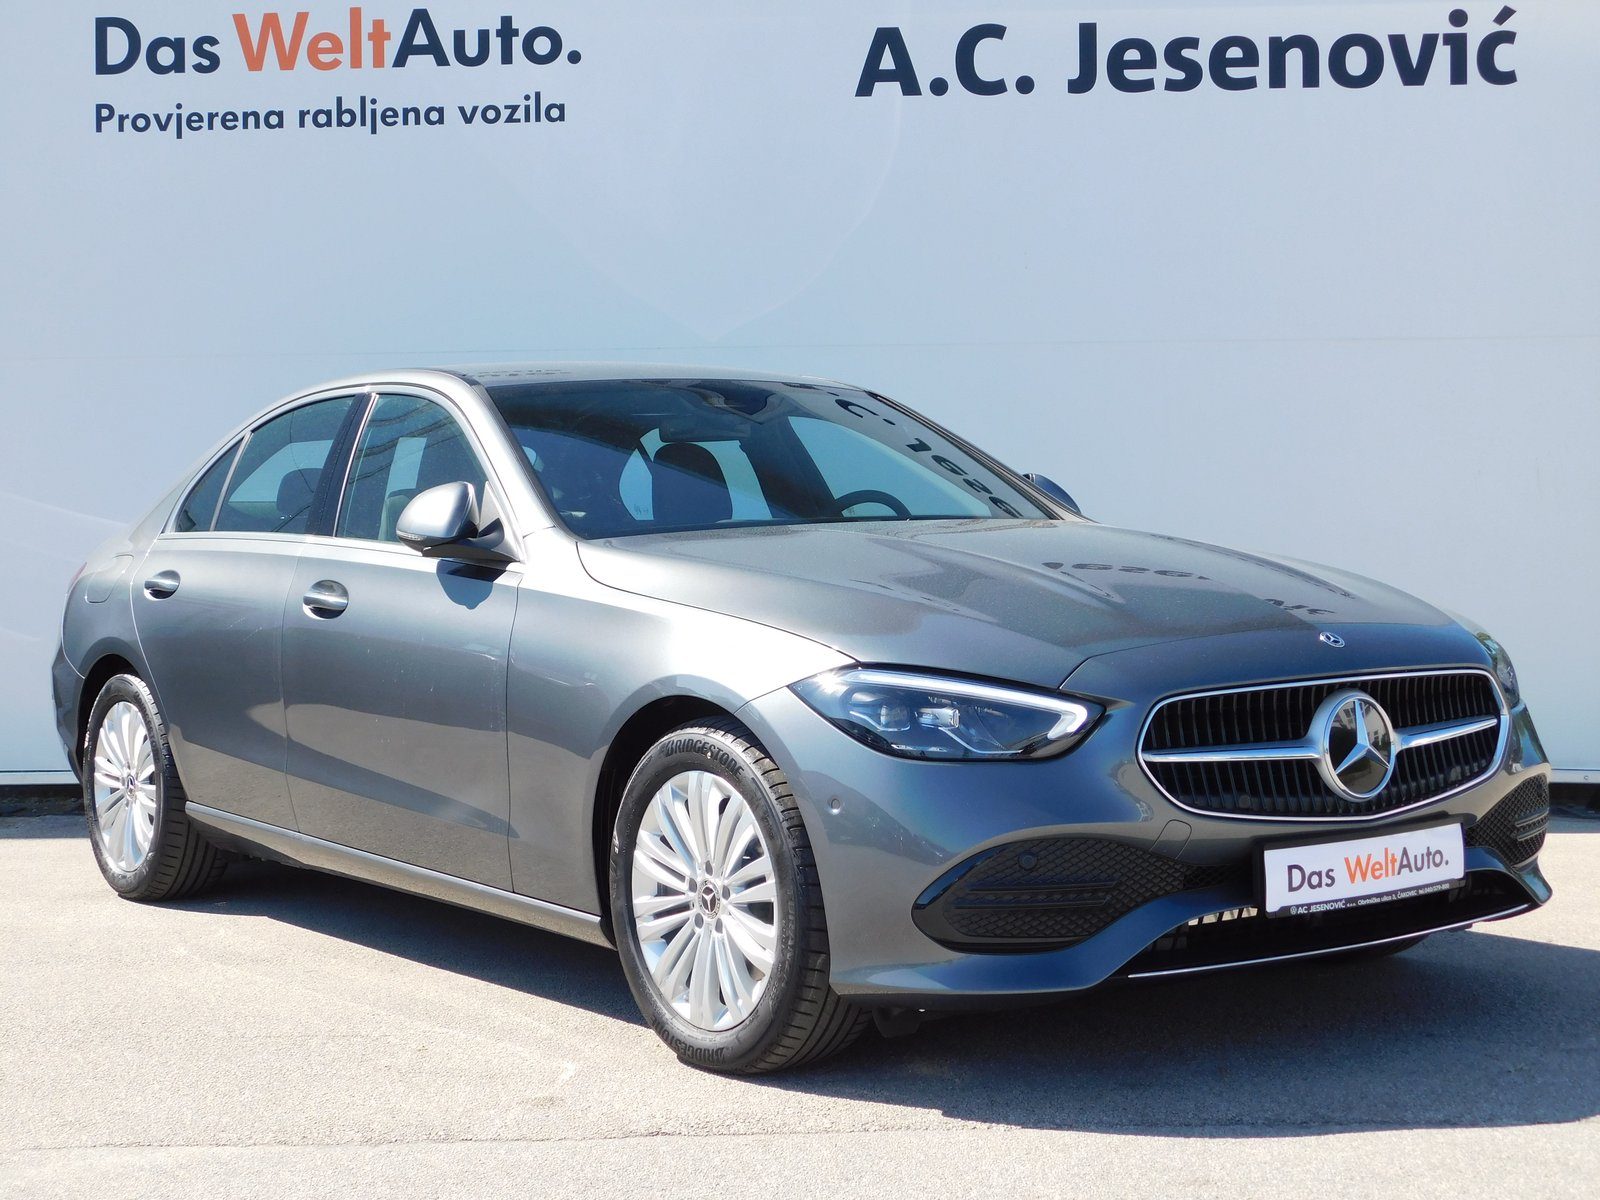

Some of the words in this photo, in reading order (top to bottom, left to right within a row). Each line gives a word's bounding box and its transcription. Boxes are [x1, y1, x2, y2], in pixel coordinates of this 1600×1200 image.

[94, 16, 221, 75] Das
[232, 7, 582, 72] WeltAuto.
[854, 23, 1036, 97] A.C.
[1066, 6, 1518, 94] Jesenović
[95, 102, 285, 140] Provjerena
[298, 95, 445, 135] rabljena
[457, 90, 566, 125] vozila
[664, 738, 745, 780] BRIDGESTONE
[1287, 864, 1336, 893] Das
[1344, 846, 1450, 884] WeltAuto.
[1297, 906, 1309, 915] AC
[1309, 899, 1346, 913] JESENOVIĆ
